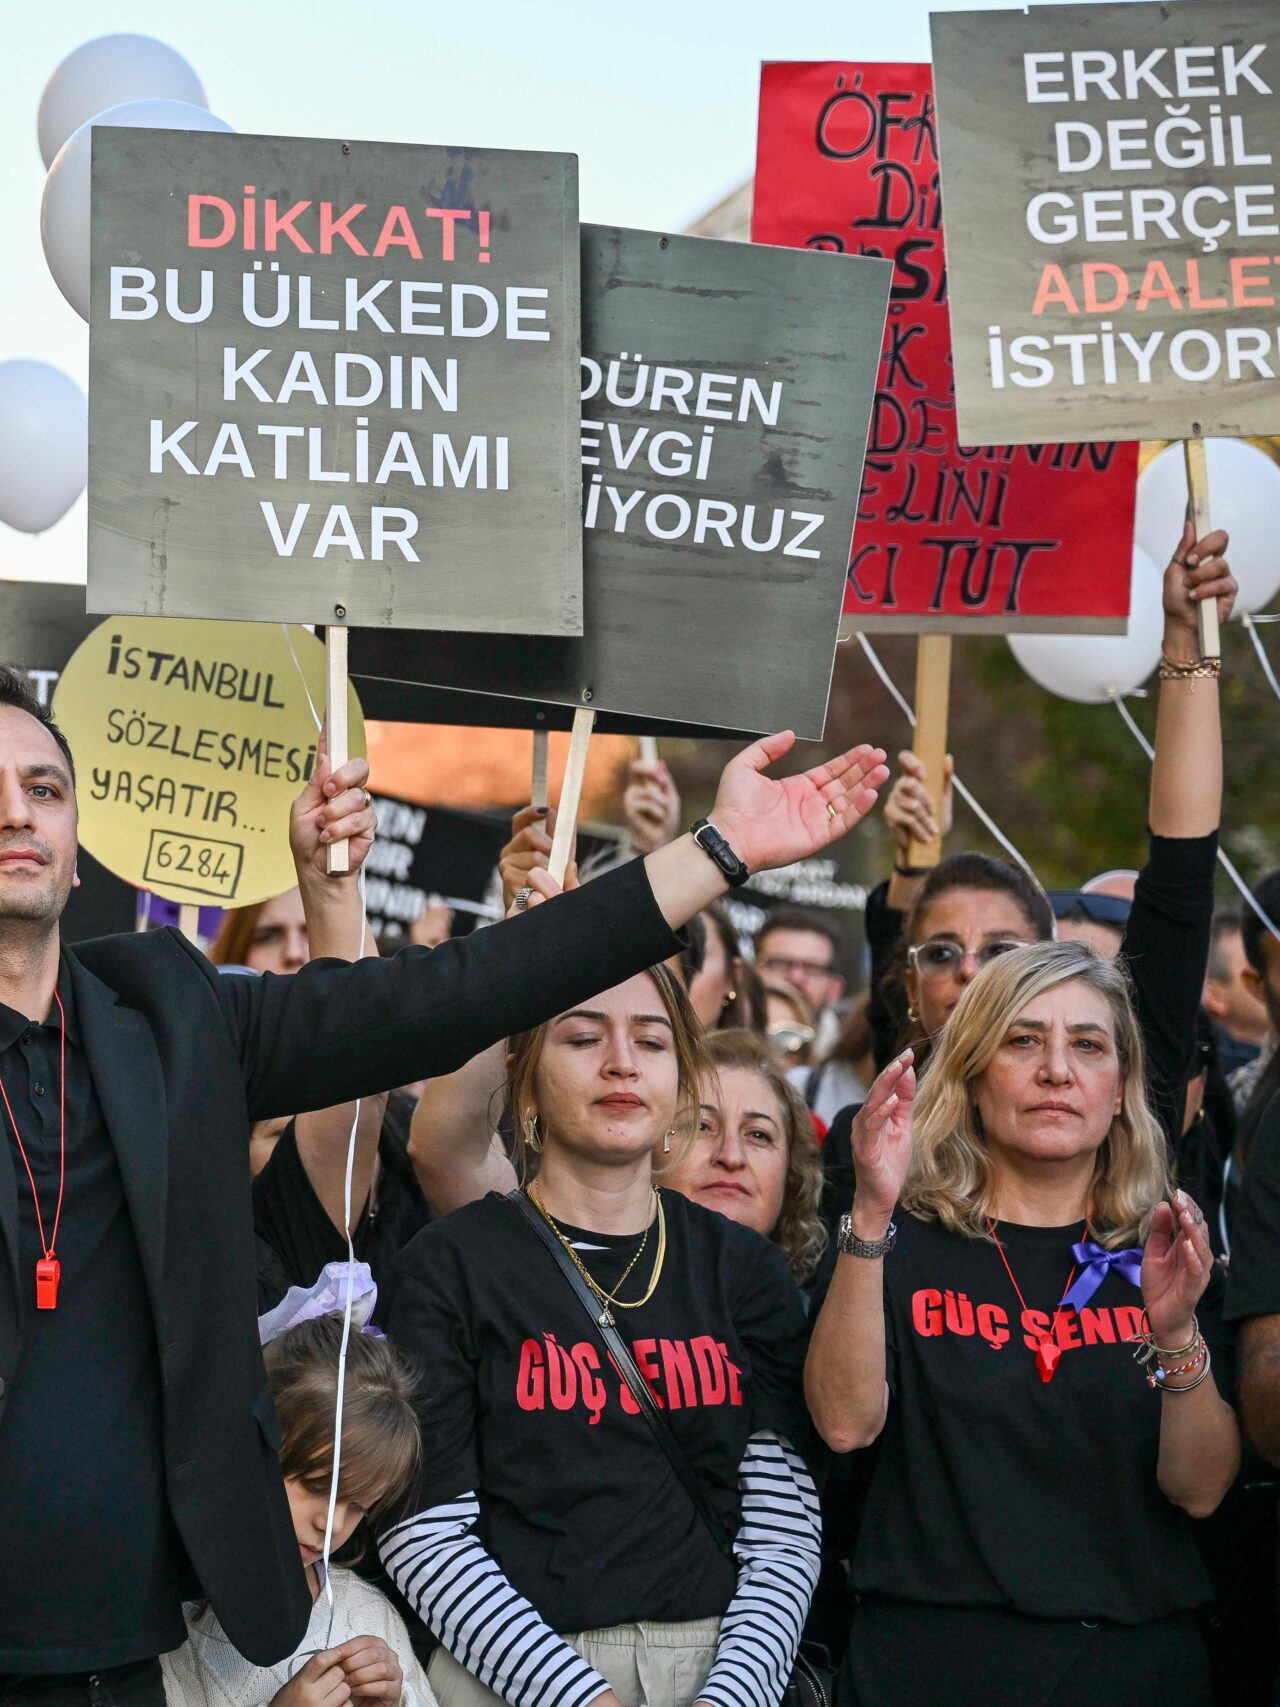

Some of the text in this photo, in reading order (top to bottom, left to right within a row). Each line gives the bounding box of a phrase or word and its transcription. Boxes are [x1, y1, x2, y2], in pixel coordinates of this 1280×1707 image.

[1024, 44, 1272, 103] ERKEK
[1055, 104, 1272, 172] DEĞİL
[187, 185, 491, 264] DİKKAT!
[109, 262, 550, 341] BU ÜLKEDE
[1031, 254, 1280, 315] ADALE
[223, 347, 458, 412] KADIN
[989, 321, 1280, 388] İSTİYOR
[149, 416, 509, 490] KATLİAMI
[259, 501, 421, 562] VAR
[922, 536, 1061, 614] TUT
[107, 634, 284, 708] İSTANBUL
[107, 709, 317, 783] SÖZLEŞMESİ
[157, 841, 230, 884] 6284
[911, 1288, 1010, 1350] GÜÇ
[516, 1330, 606, 1425] GÜÇ
